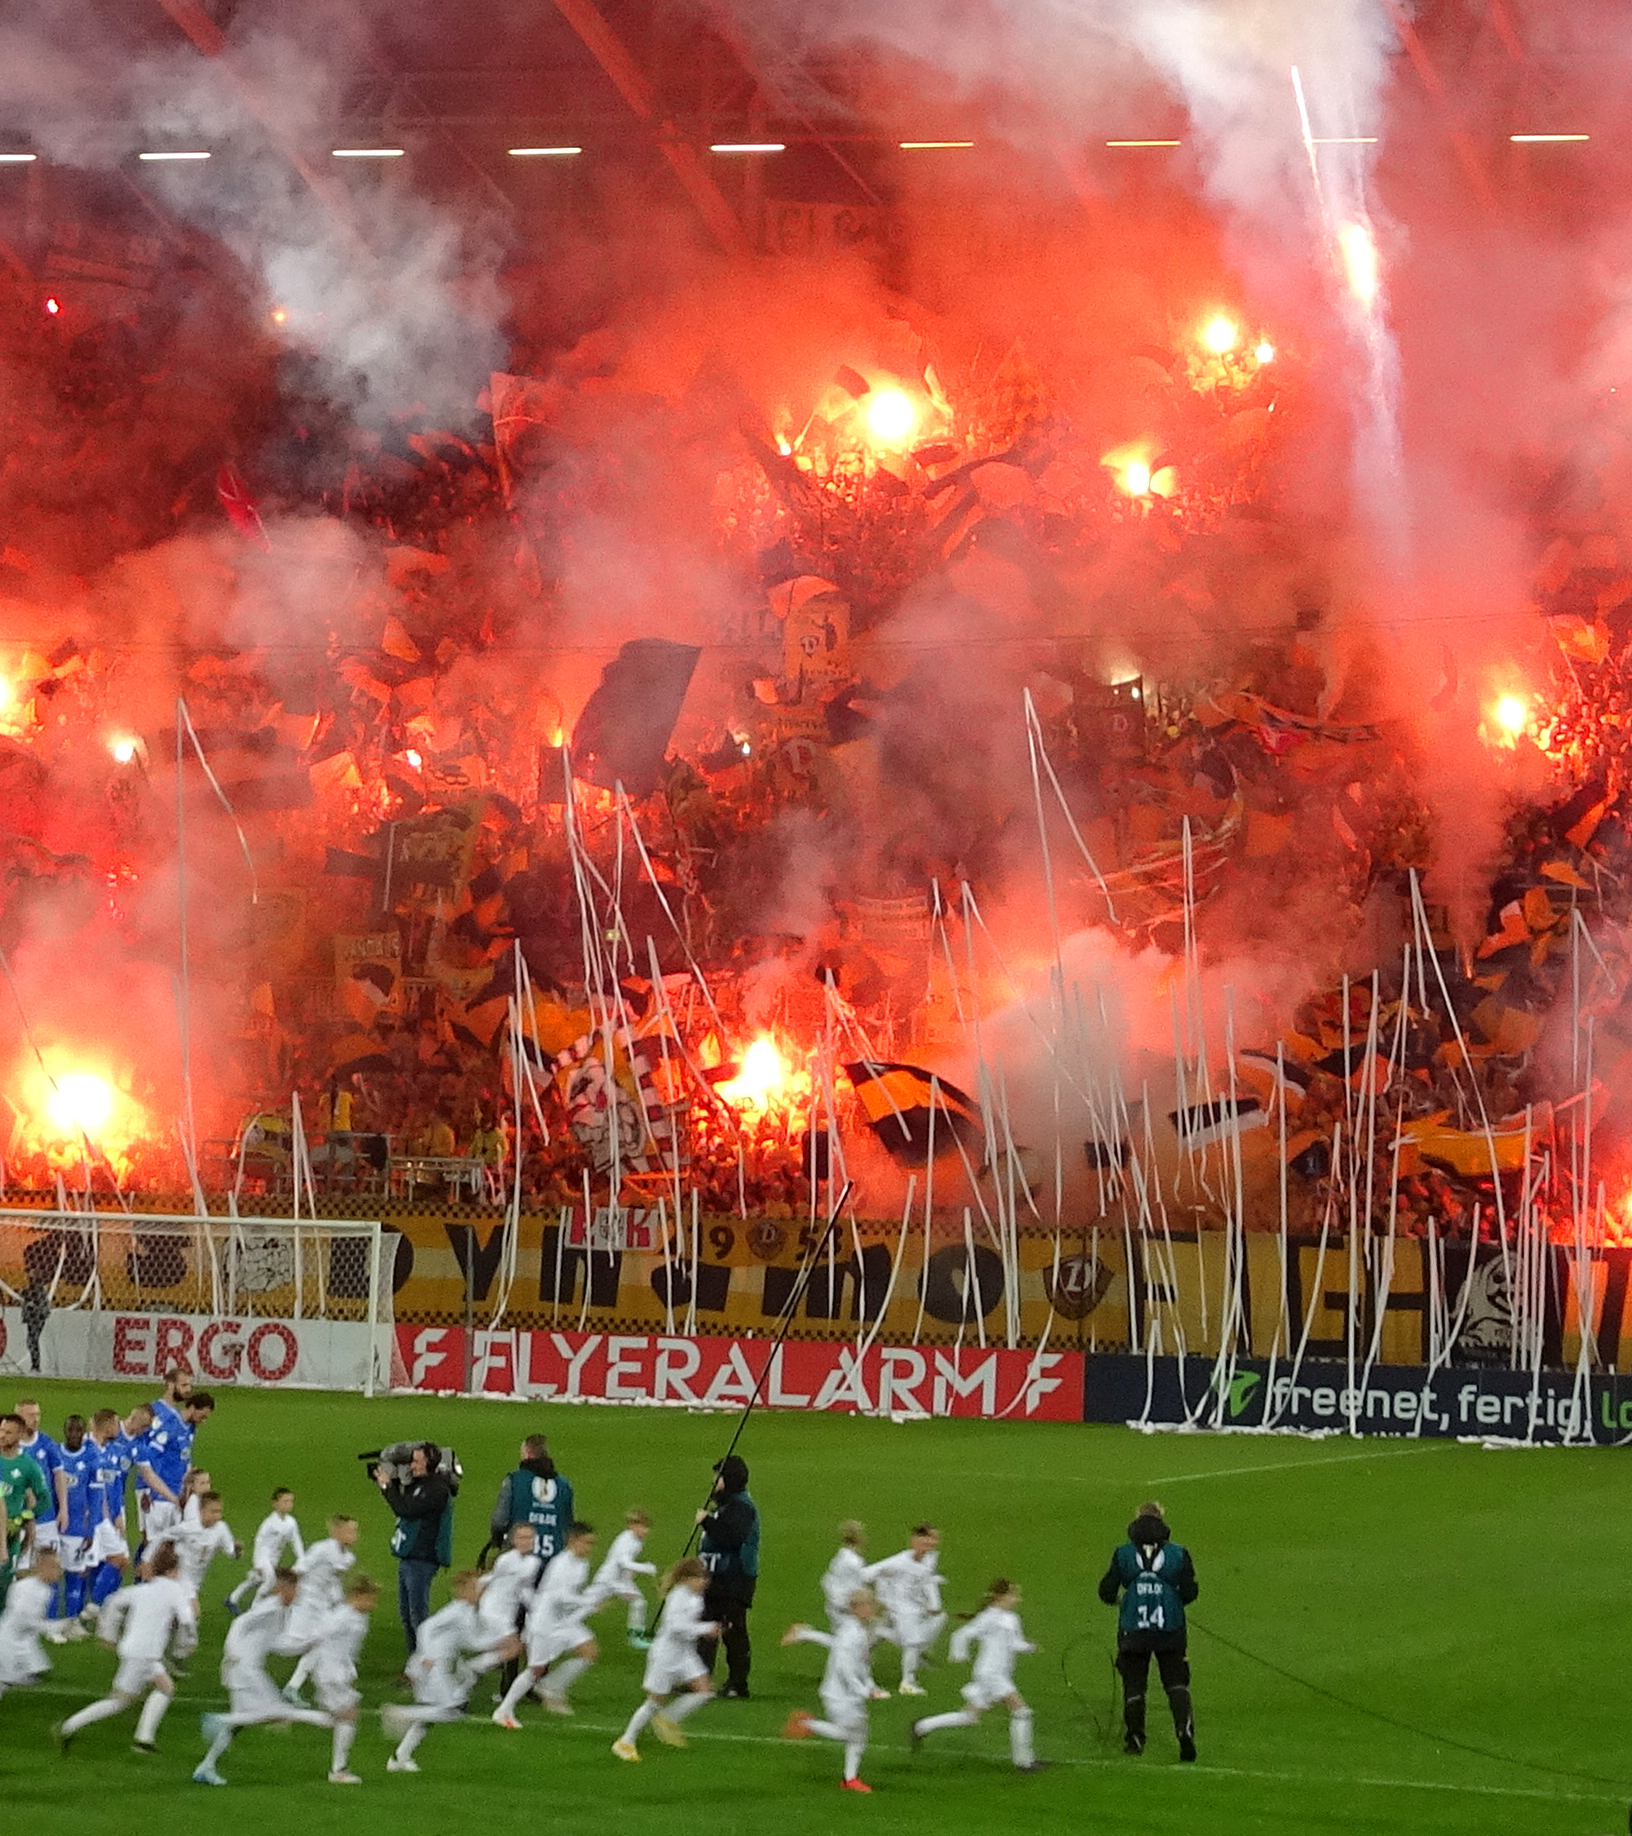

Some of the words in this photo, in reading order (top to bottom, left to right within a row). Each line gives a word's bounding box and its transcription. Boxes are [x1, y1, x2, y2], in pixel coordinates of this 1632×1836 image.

[112, 1315, 299, 1381] ERGO
[471, 1329, 996, 1417] FLYERALARM
[1273, 1377, 1450, 1432] freenet,
[1137, 1604, 1165, 1629] 14
